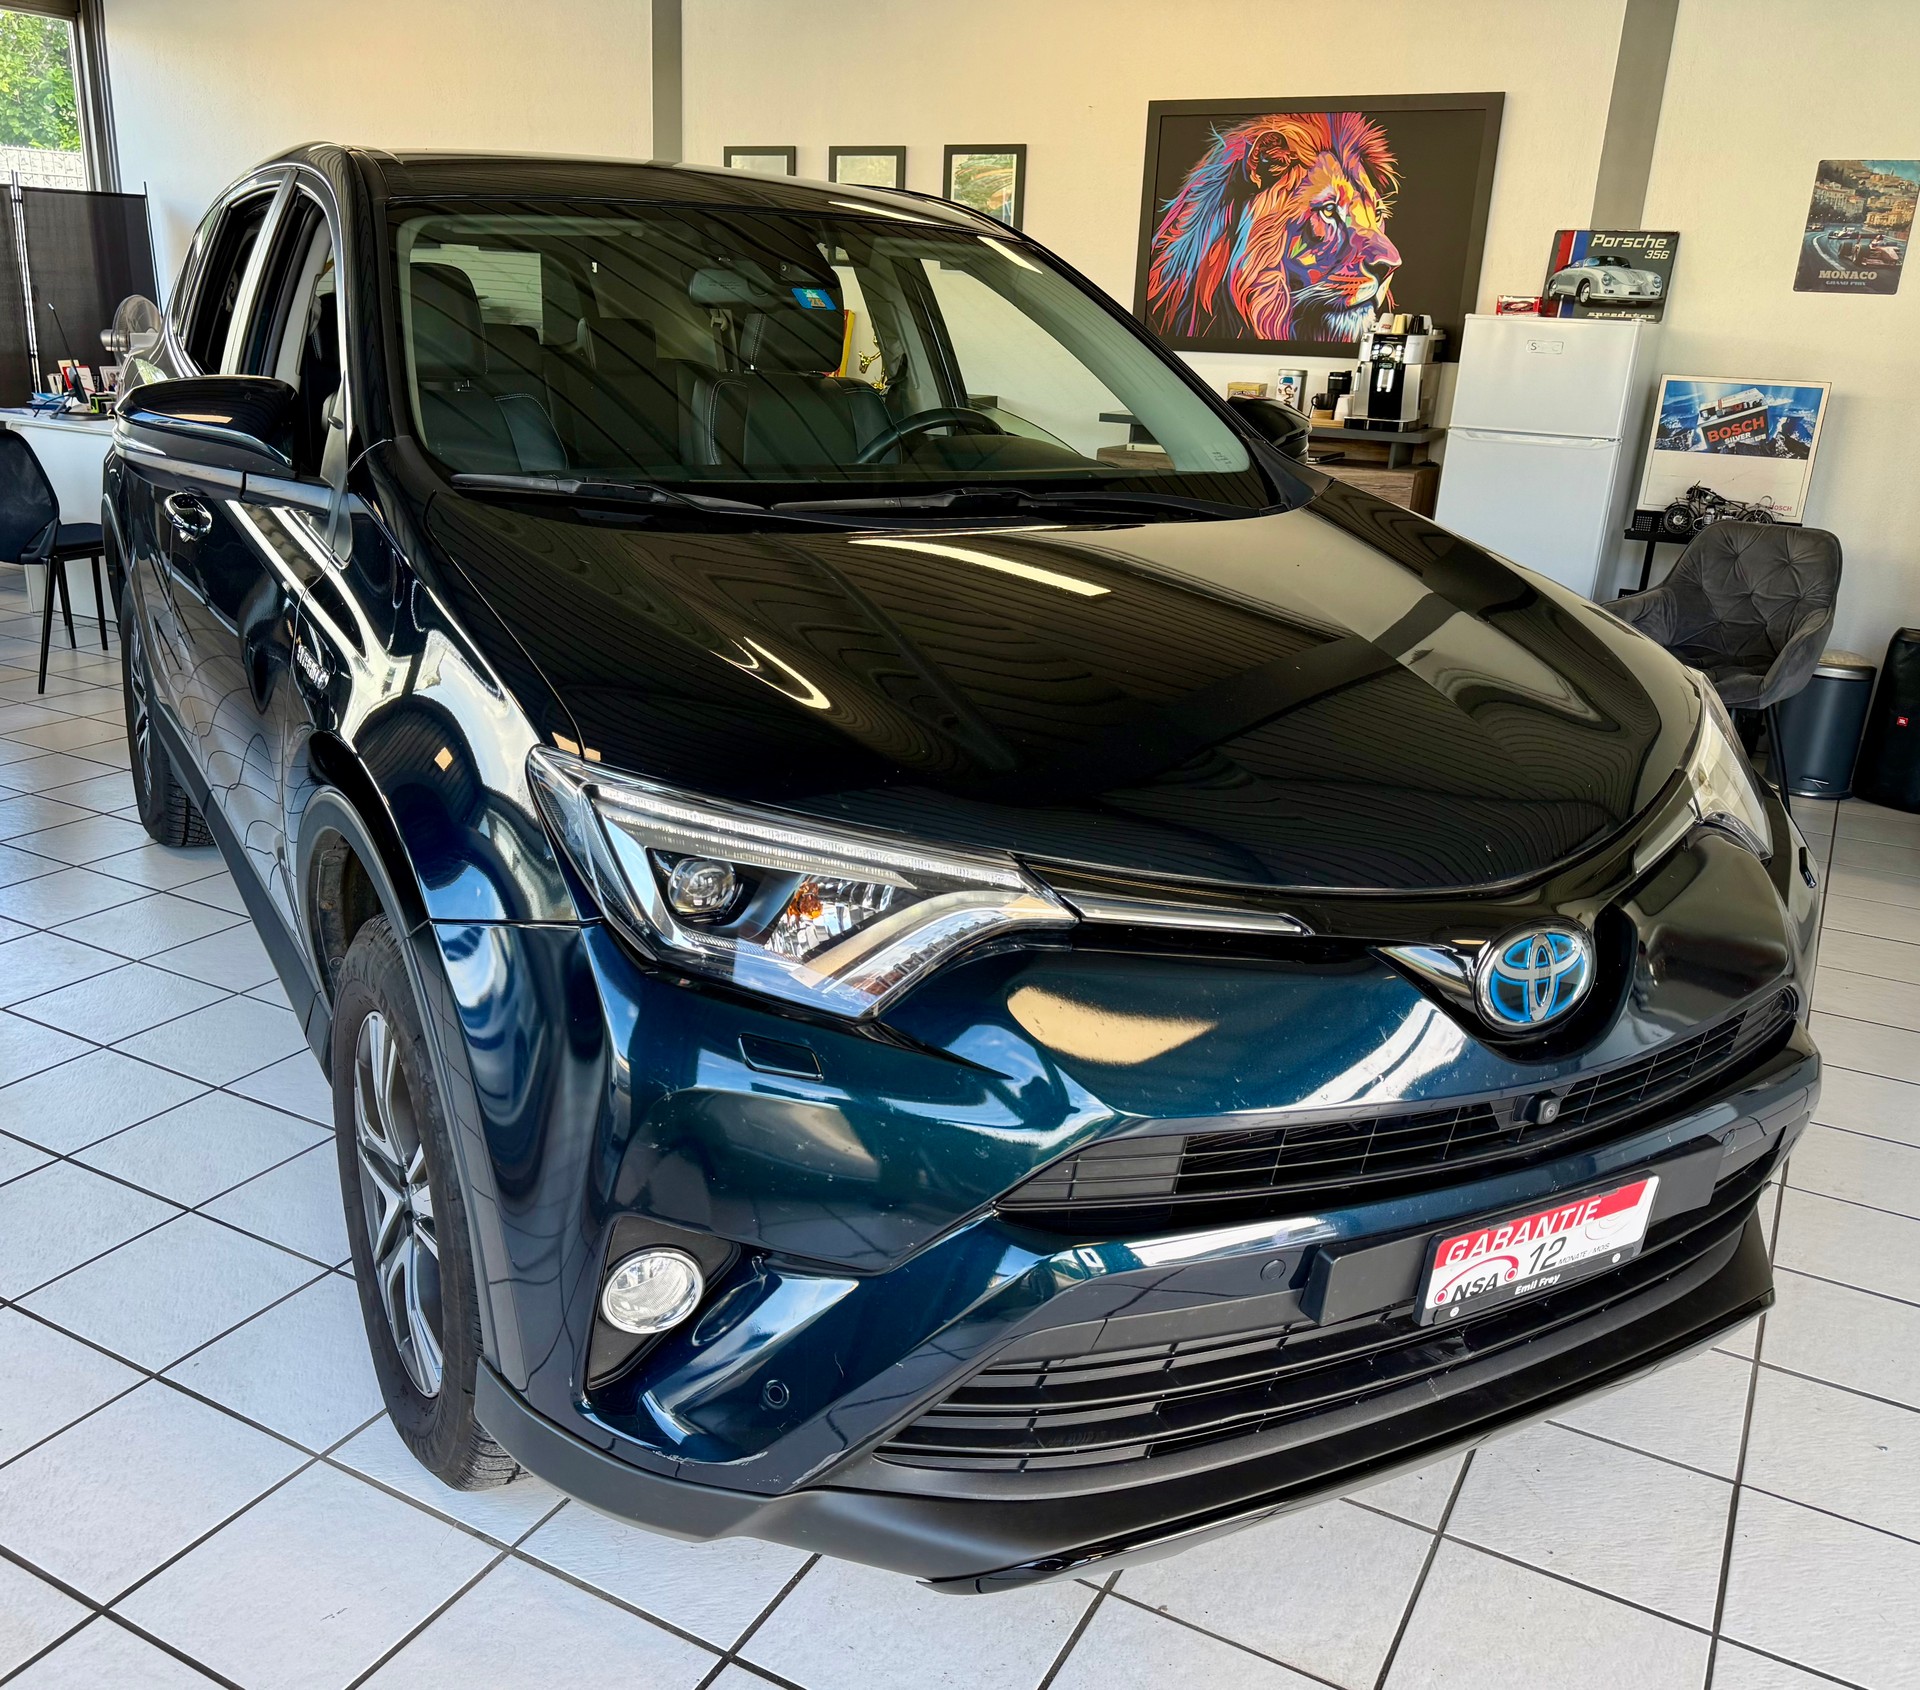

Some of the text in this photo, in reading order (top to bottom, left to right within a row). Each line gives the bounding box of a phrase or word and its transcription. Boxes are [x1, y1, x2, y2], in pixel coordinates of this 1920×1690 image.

[1591, 234, 1667, 248] Porsche
[1644, 250, 1670, 259] 356
[1818, 270, 1878, 280] MONACO
[1707, 416, 1765, 443] BOSCH
[1724, 432, 1751, 444] SILVER
[1445, 1199, 1601, 1266] GARANTIE
[1529, 1236, 1567, 1275] 12
[1449, 1272, 1499, 1303] NSA
[1515, 1274, 1560, 1296] Emil Frey
